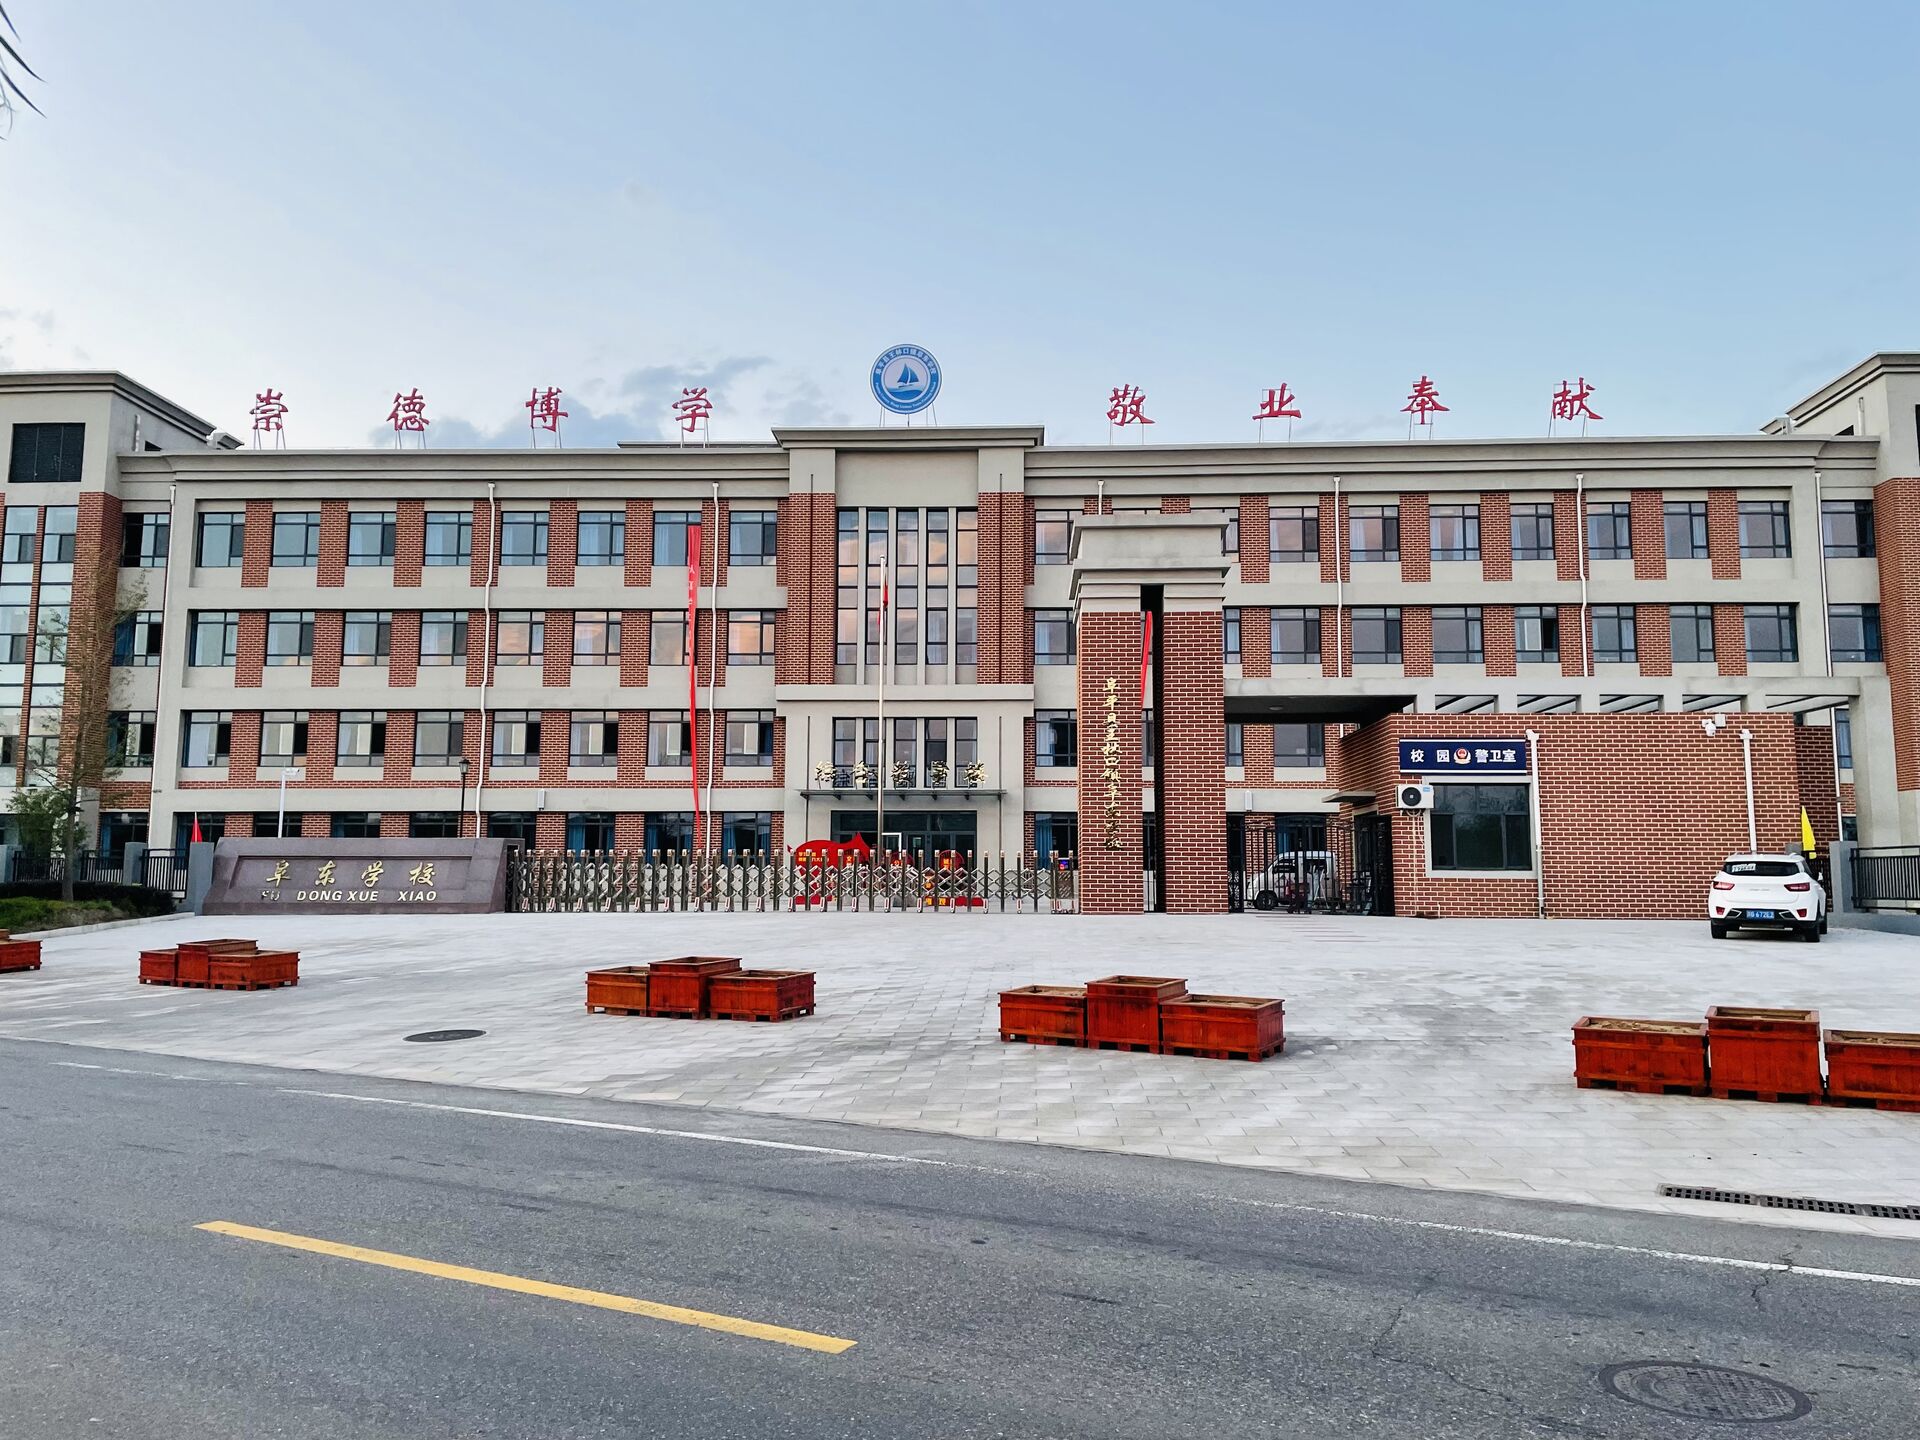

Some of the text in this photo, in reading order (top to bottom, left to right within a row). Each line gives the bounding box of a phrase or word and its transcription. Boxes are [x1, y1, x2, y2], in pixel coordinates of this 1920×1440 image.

[249, 386, 714, 433] 崇德博学
[1106, 375, 1604, 427] 敬业奉献
[1410, 748, 1517, 764] 校园 警卫室
[265, 859, 437, 888] 阜东学校
[296, 890, 342, 902] DONG
[346, 890, 379, 902] XUE
[397, 890, 437, 902] XIAO
